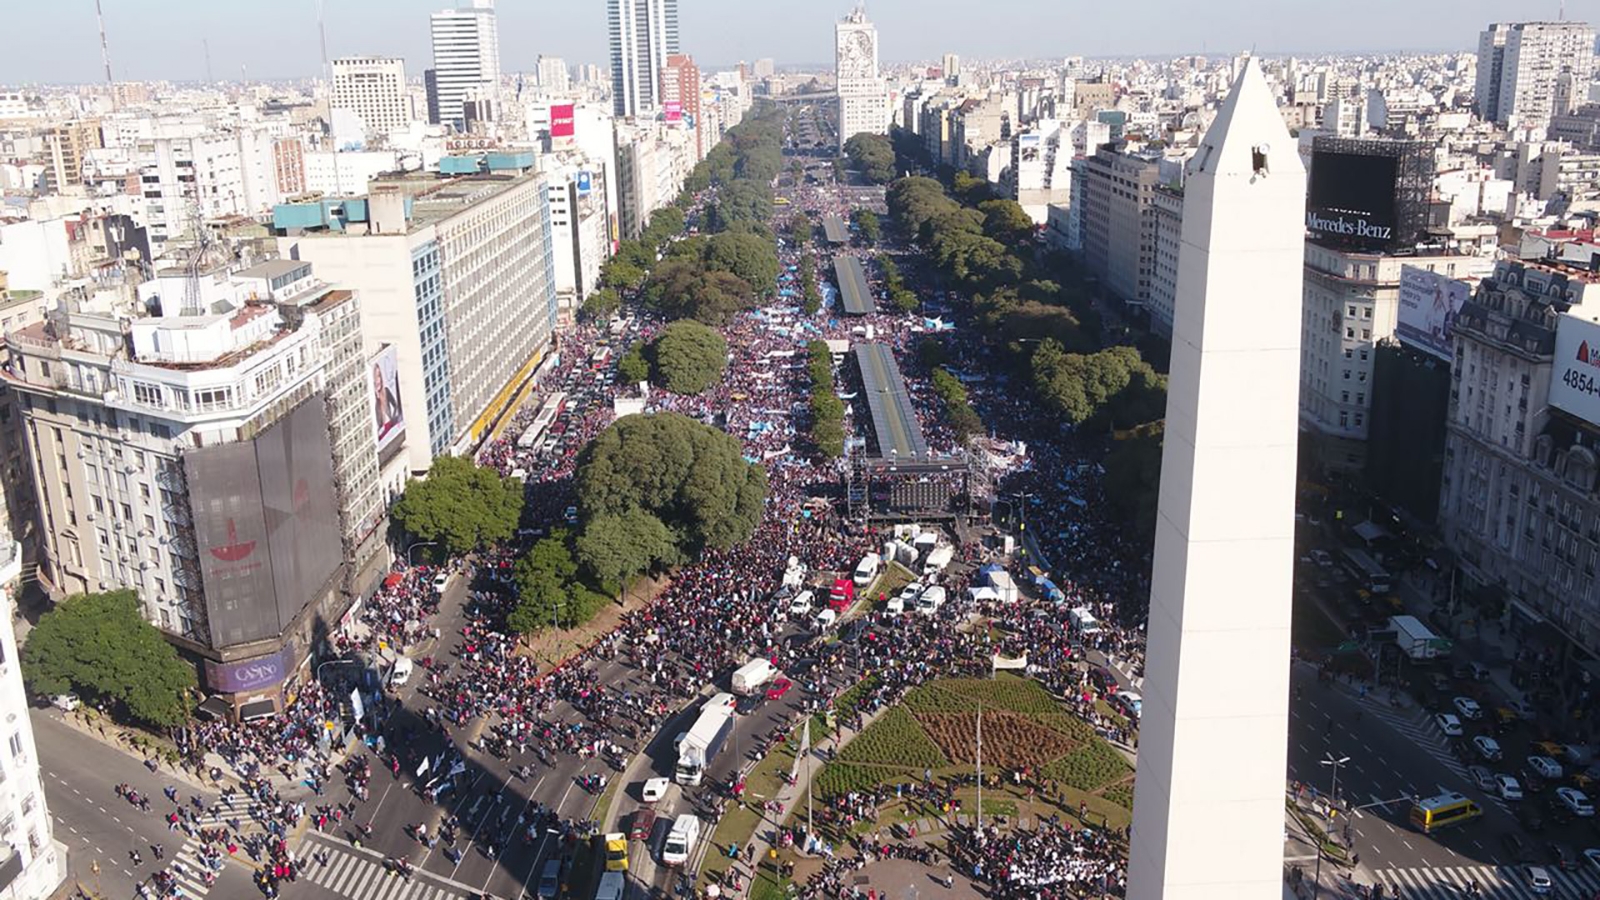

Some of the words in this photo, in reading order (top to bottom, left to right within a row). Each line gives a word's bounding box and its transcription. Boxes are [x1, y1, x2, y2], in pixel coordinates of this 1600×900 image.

[1307, 212, 1391, 239] Mercedes-Benz
[1563, 368, 1600, 398] 4854-
[235, 664, 277, 681] CASINO
